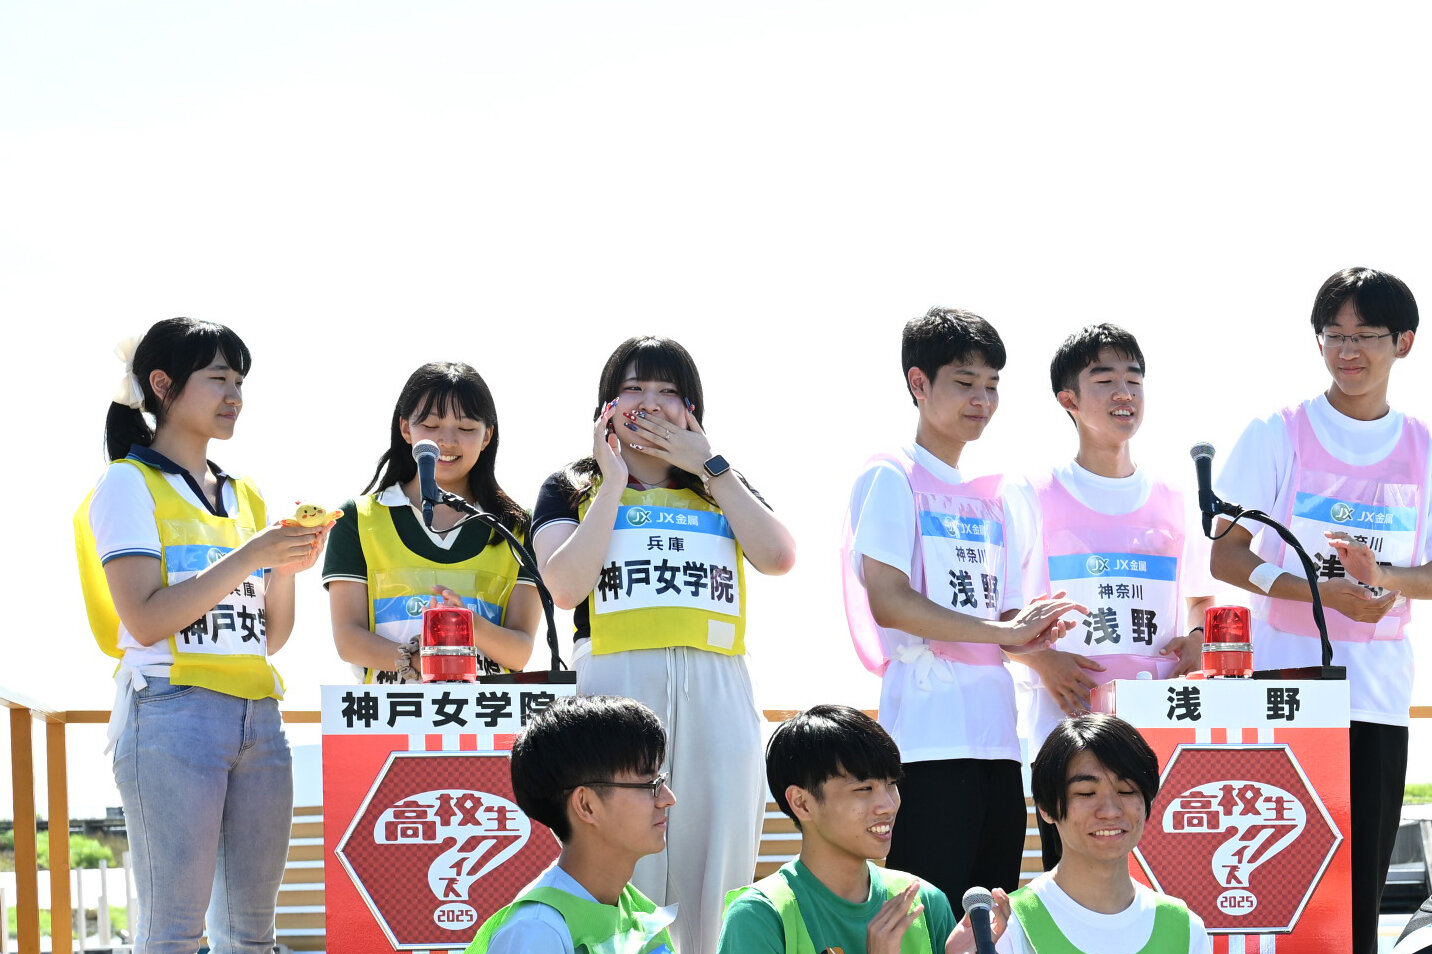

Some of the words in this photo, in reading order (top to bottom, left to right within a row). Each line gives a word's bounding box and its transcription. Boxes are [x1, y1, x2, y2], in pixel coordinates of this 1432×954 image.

[646, 535, 685, 552] 兵庫
[597, 558, 735, 604] 神戸女学院
[1098, 583, 1144, 600] 神奈川
[1082, 606, 1158, 646] 浅野
[1166, 686, 1301, 722] 浅野
[385, 792, 521, 842] 高校生
[1172, 783, 1297, 831] 高校生
[437, 909, 474, 923] 2025
[1220, 895, 1254, 908] 2025
